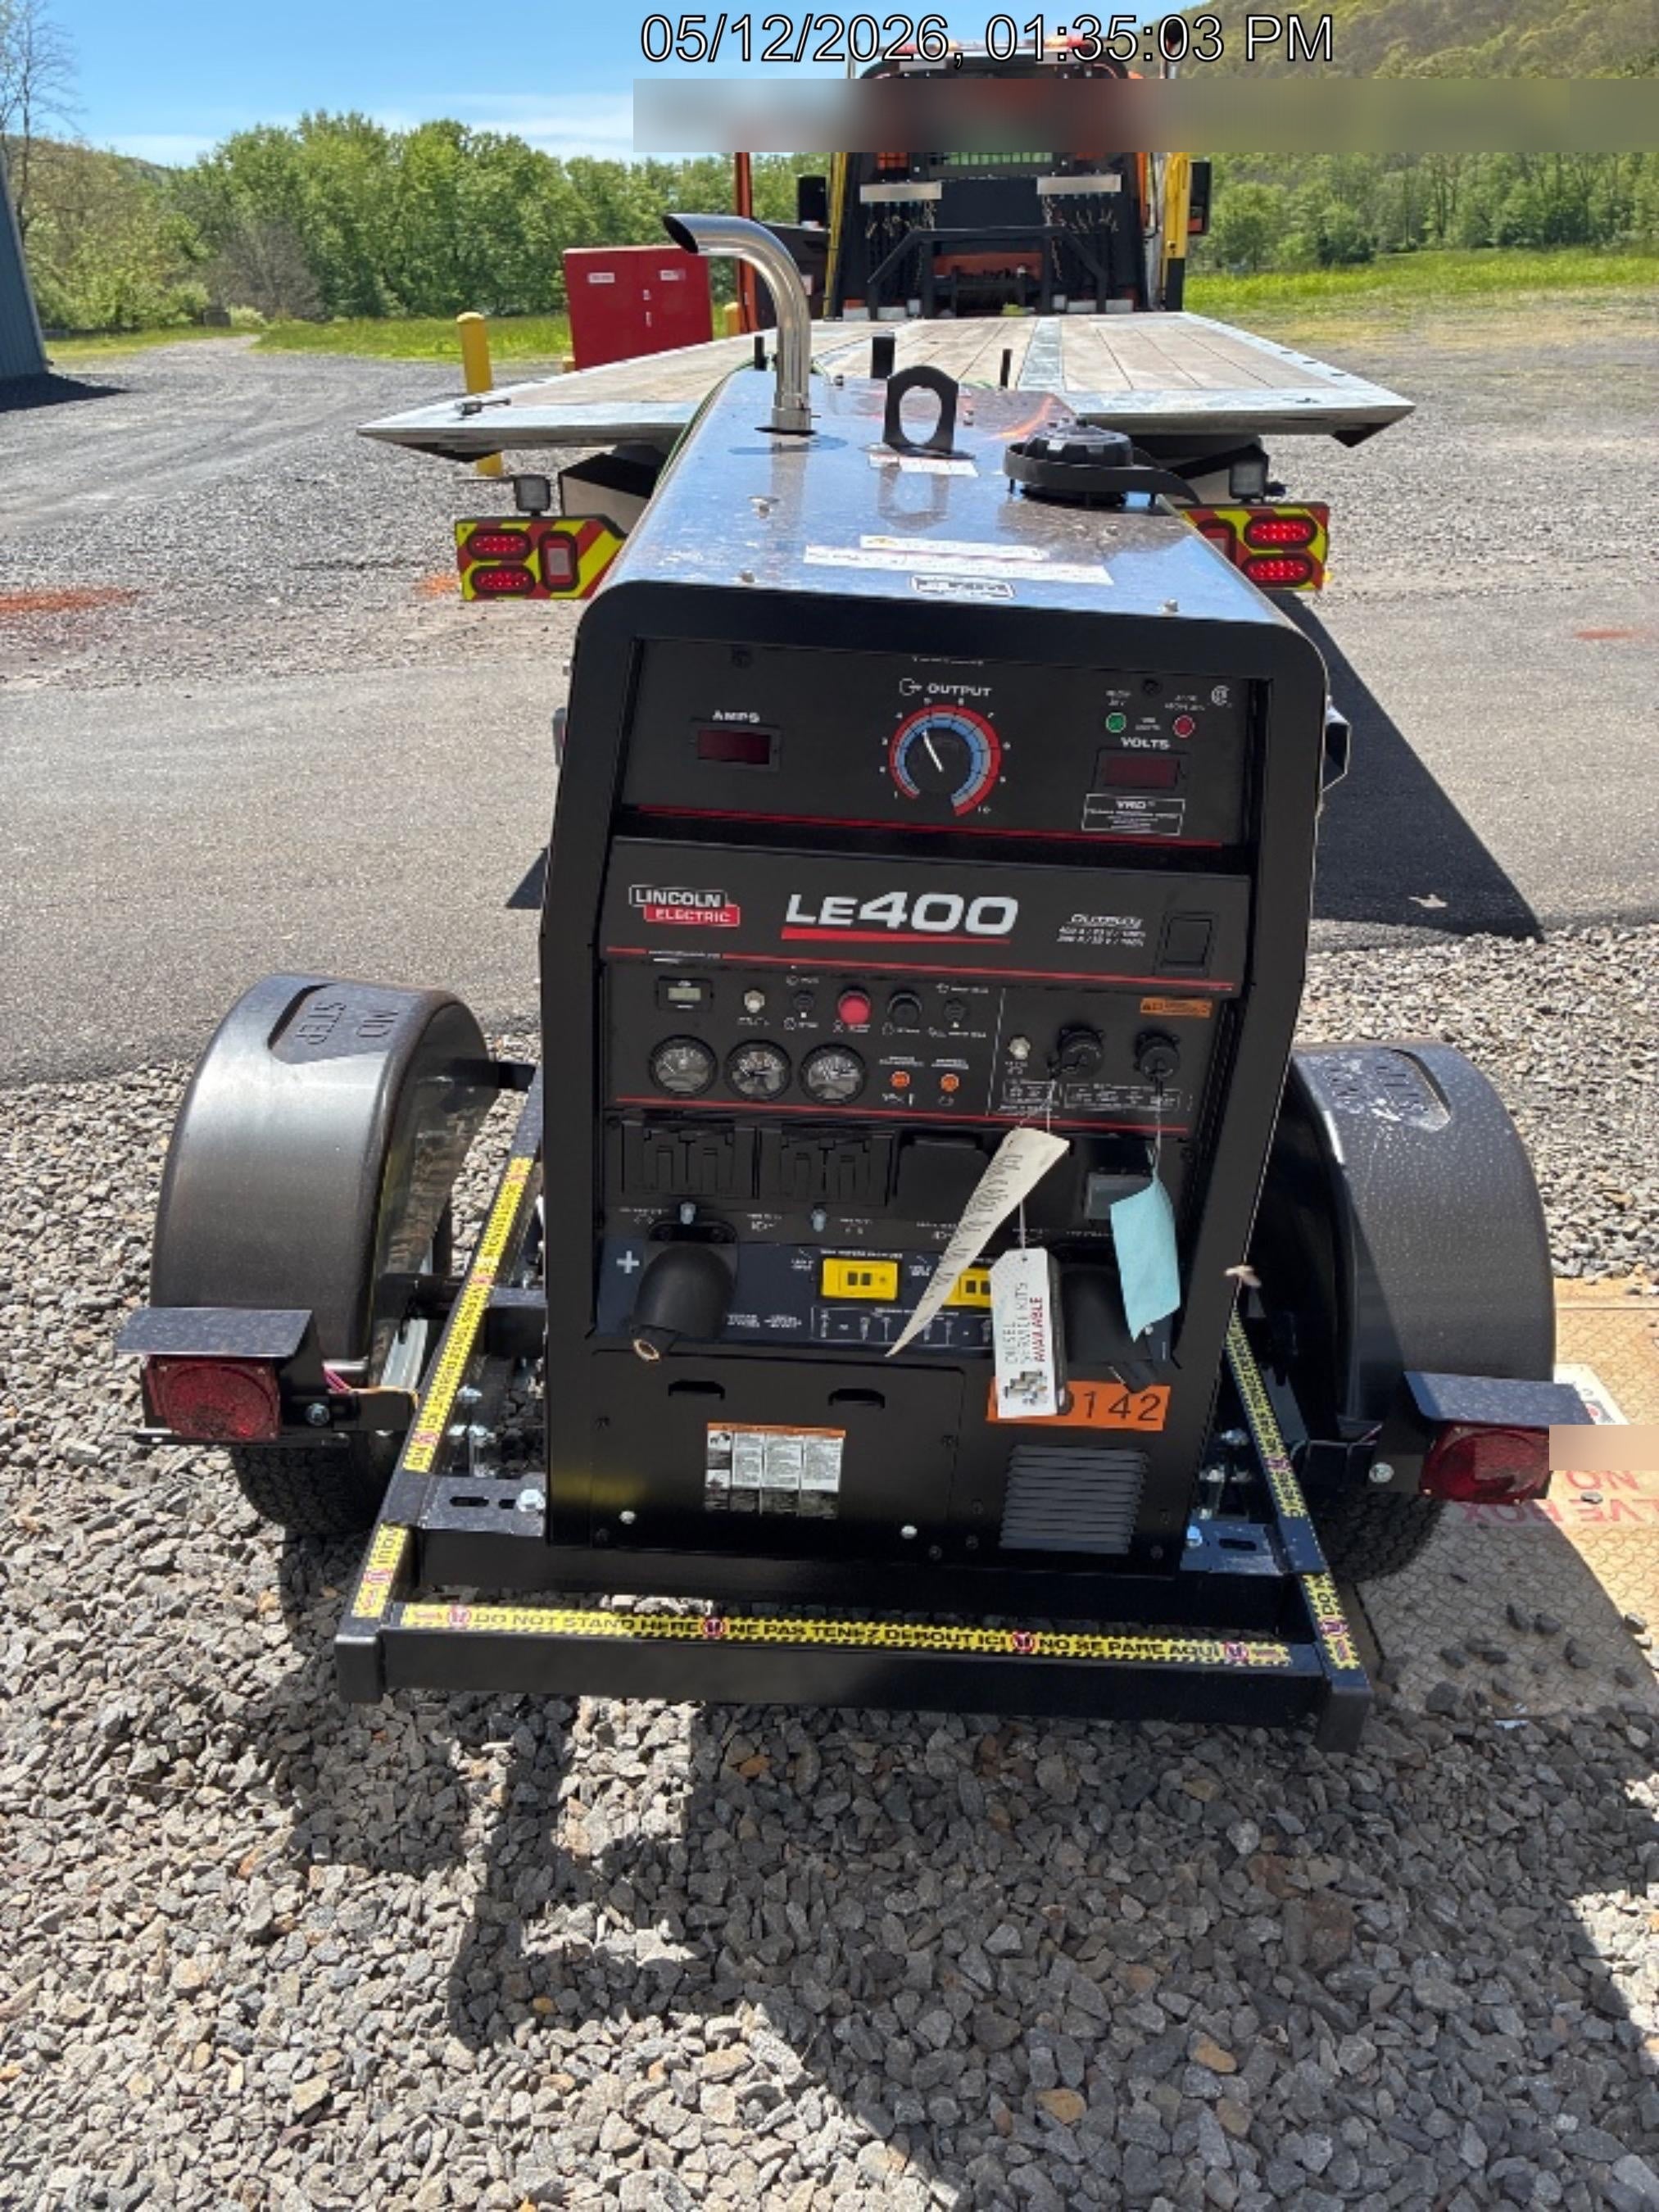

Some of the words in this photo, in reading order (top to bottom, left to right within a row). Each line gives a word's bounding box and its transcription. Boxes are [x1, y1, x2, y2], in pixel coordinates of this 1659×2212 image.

[927, 682, 992, 696] OUTPUT
[712, 709, 760, 723] AMPS
[1121, 737, 1171, 750] VOLTS
[635, 888, 722, 907] LINCOLN
[655, 908, 730, 923] ELECTRIC
[786, 891, 1019, 935] LE400
[296, 1001, 348, 1046] STEP
[356, 1008, 399, 1040] NO
[1014, 1281, 1029, 1312] KITS
[1030, 1296, 1045, 1363] AVAILABLE
[474, 1616, 506, 1624] DO
[512, 1616, 555, 1626] NOT
[562, 1617, 634, 1630] STAND
[640, 1620, 699, 1633] HERE
[729, 1625, 759, 1635] NE
[763, 1625, 808, 1636] PAS
[811, 1626, 882, 1639] TENEZ
[884, 1629, 976, 1643] DEBOUT
[977, 1634, 1007, 1645] ICI
[1039, 1639, 1071, 1649] NO
[1075, 1640, 1104, 1652] SE
[1107, 1643, 1167, 1655] PARE
